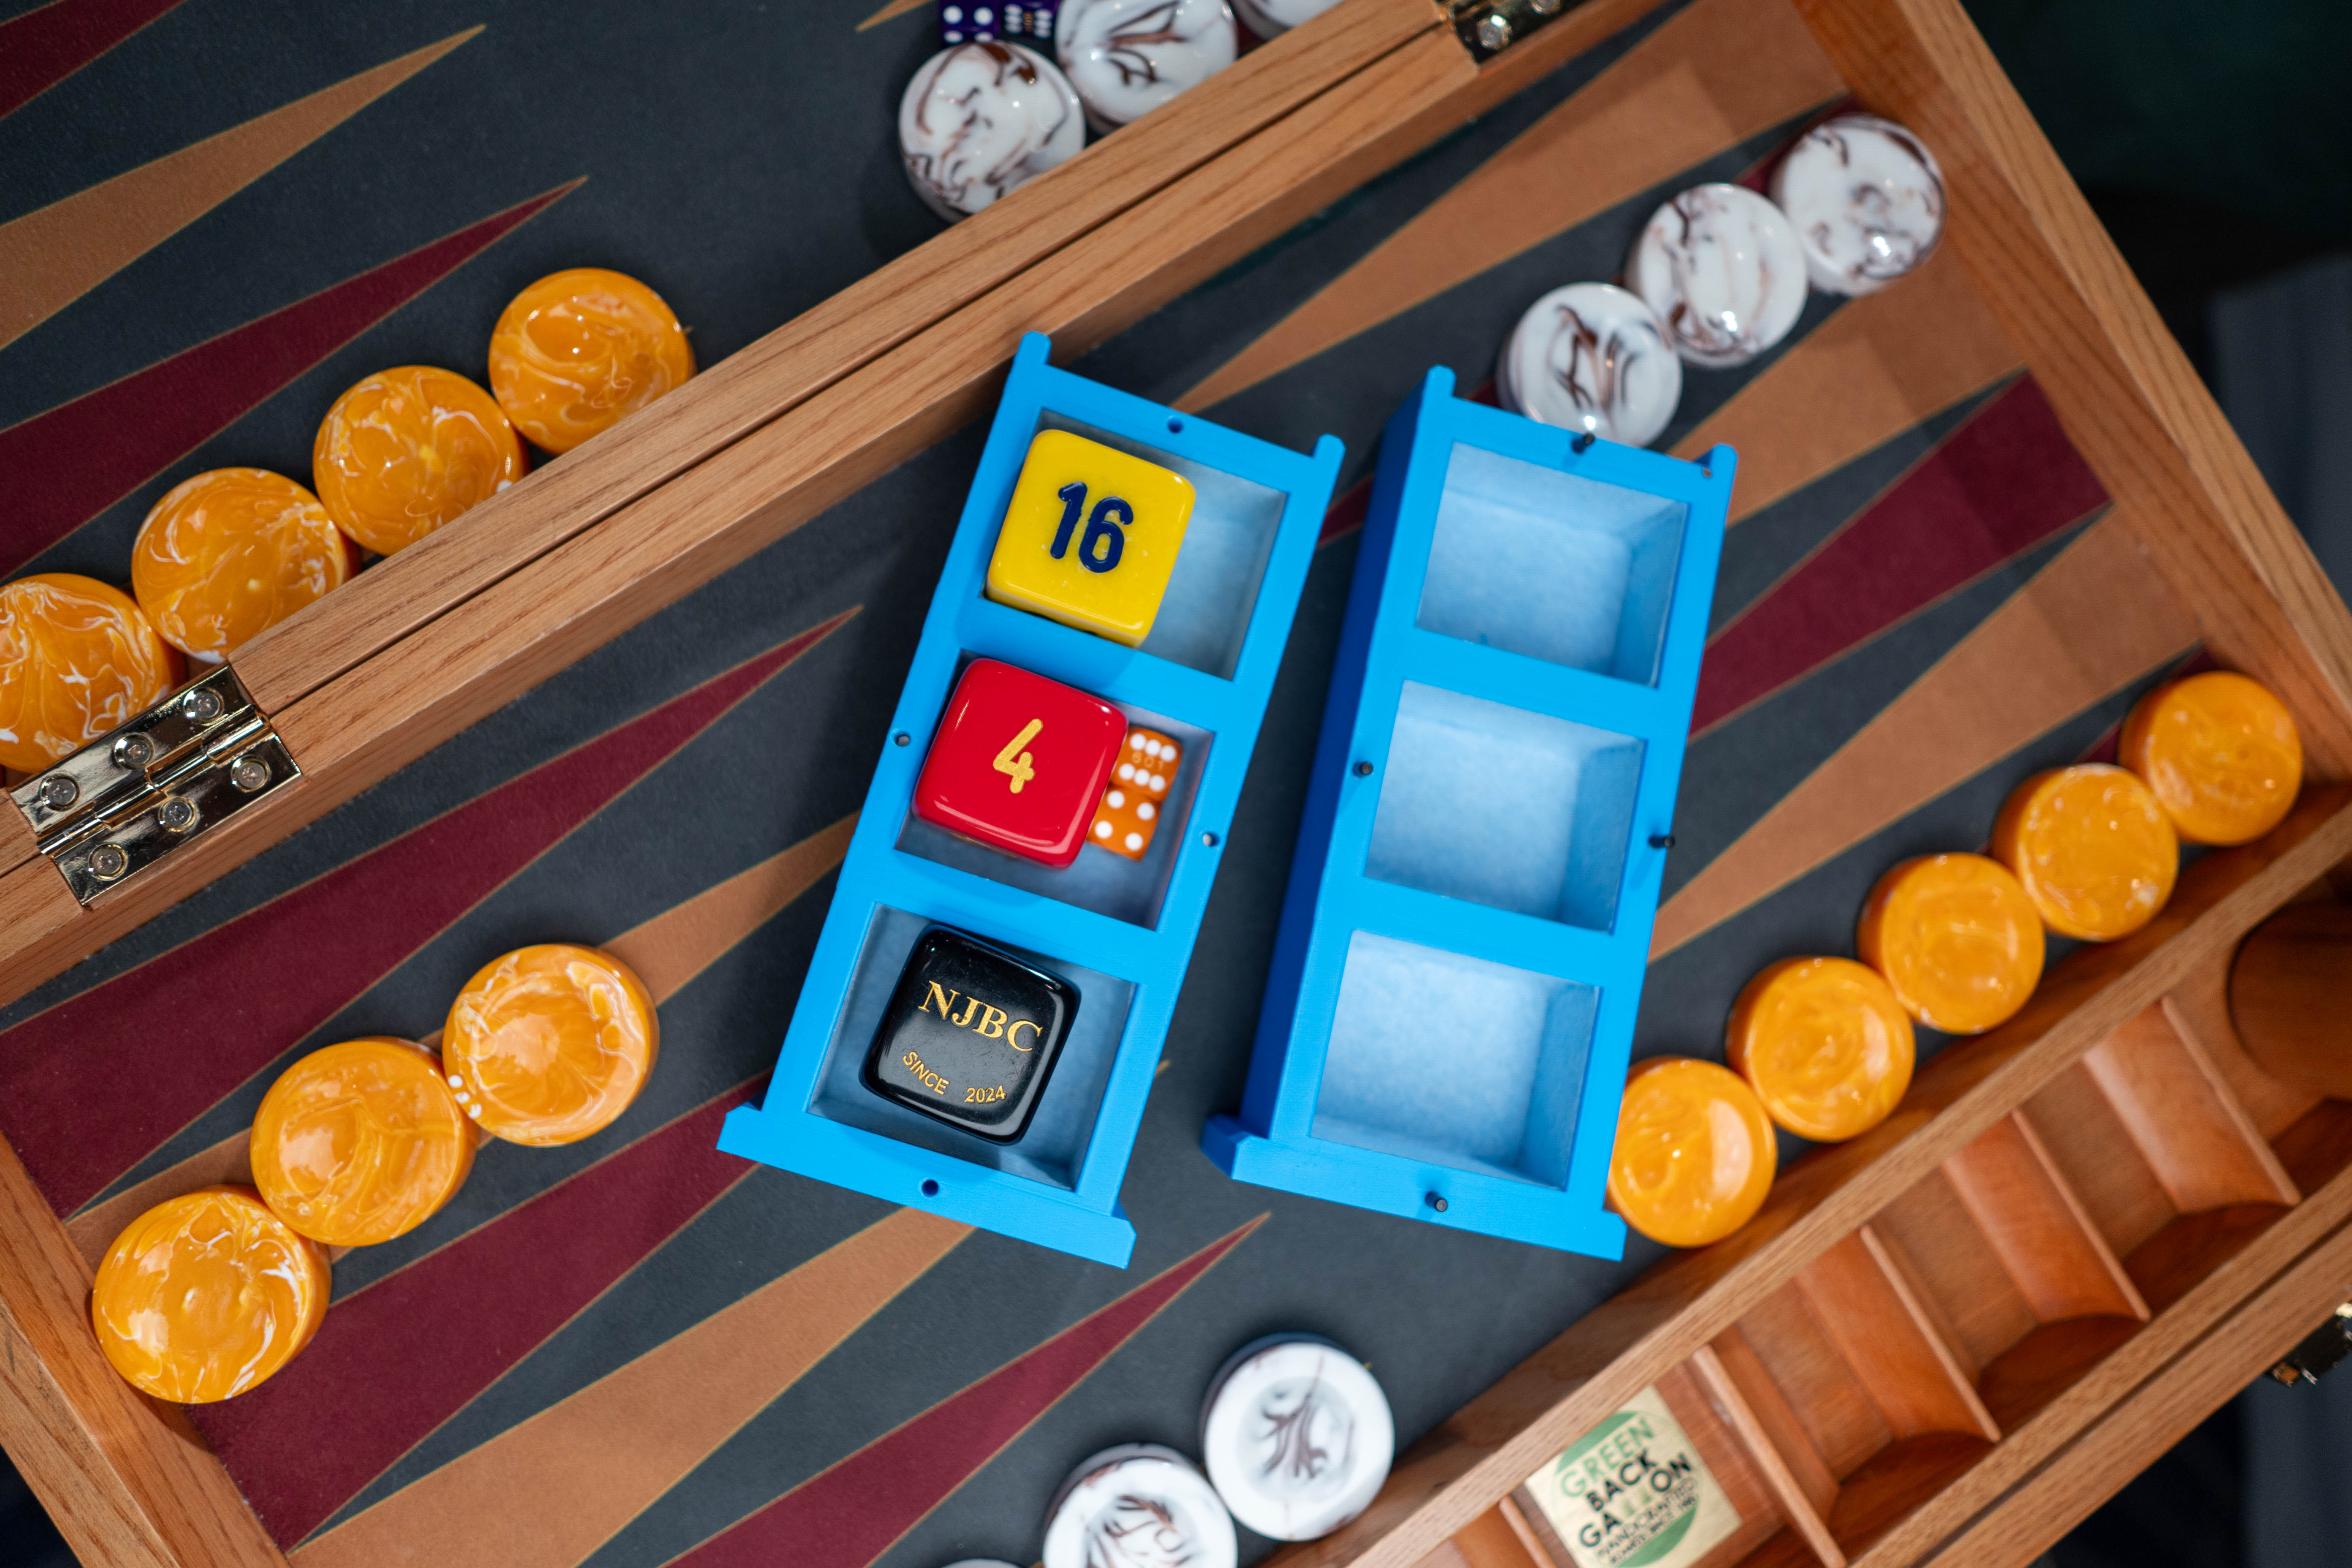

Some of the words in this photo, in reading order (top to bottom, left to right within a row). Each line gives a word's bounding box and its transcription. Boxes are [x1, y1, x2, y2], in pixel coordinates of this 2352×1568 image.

[1050, 481, 1133, 573] 16
[993, 718, 1043, 793] 4
[918, 980, 1043, 1052] NJBC
[903, 1051, 950, 1095] SINCE
[964, 1085, 1007, 1103] 2024
[1560, 1418, 1654, 1497] GREEN
[1586, 1448, 1657, 1511] BACK
[1580, 1453, 1691, 1547] GAON
